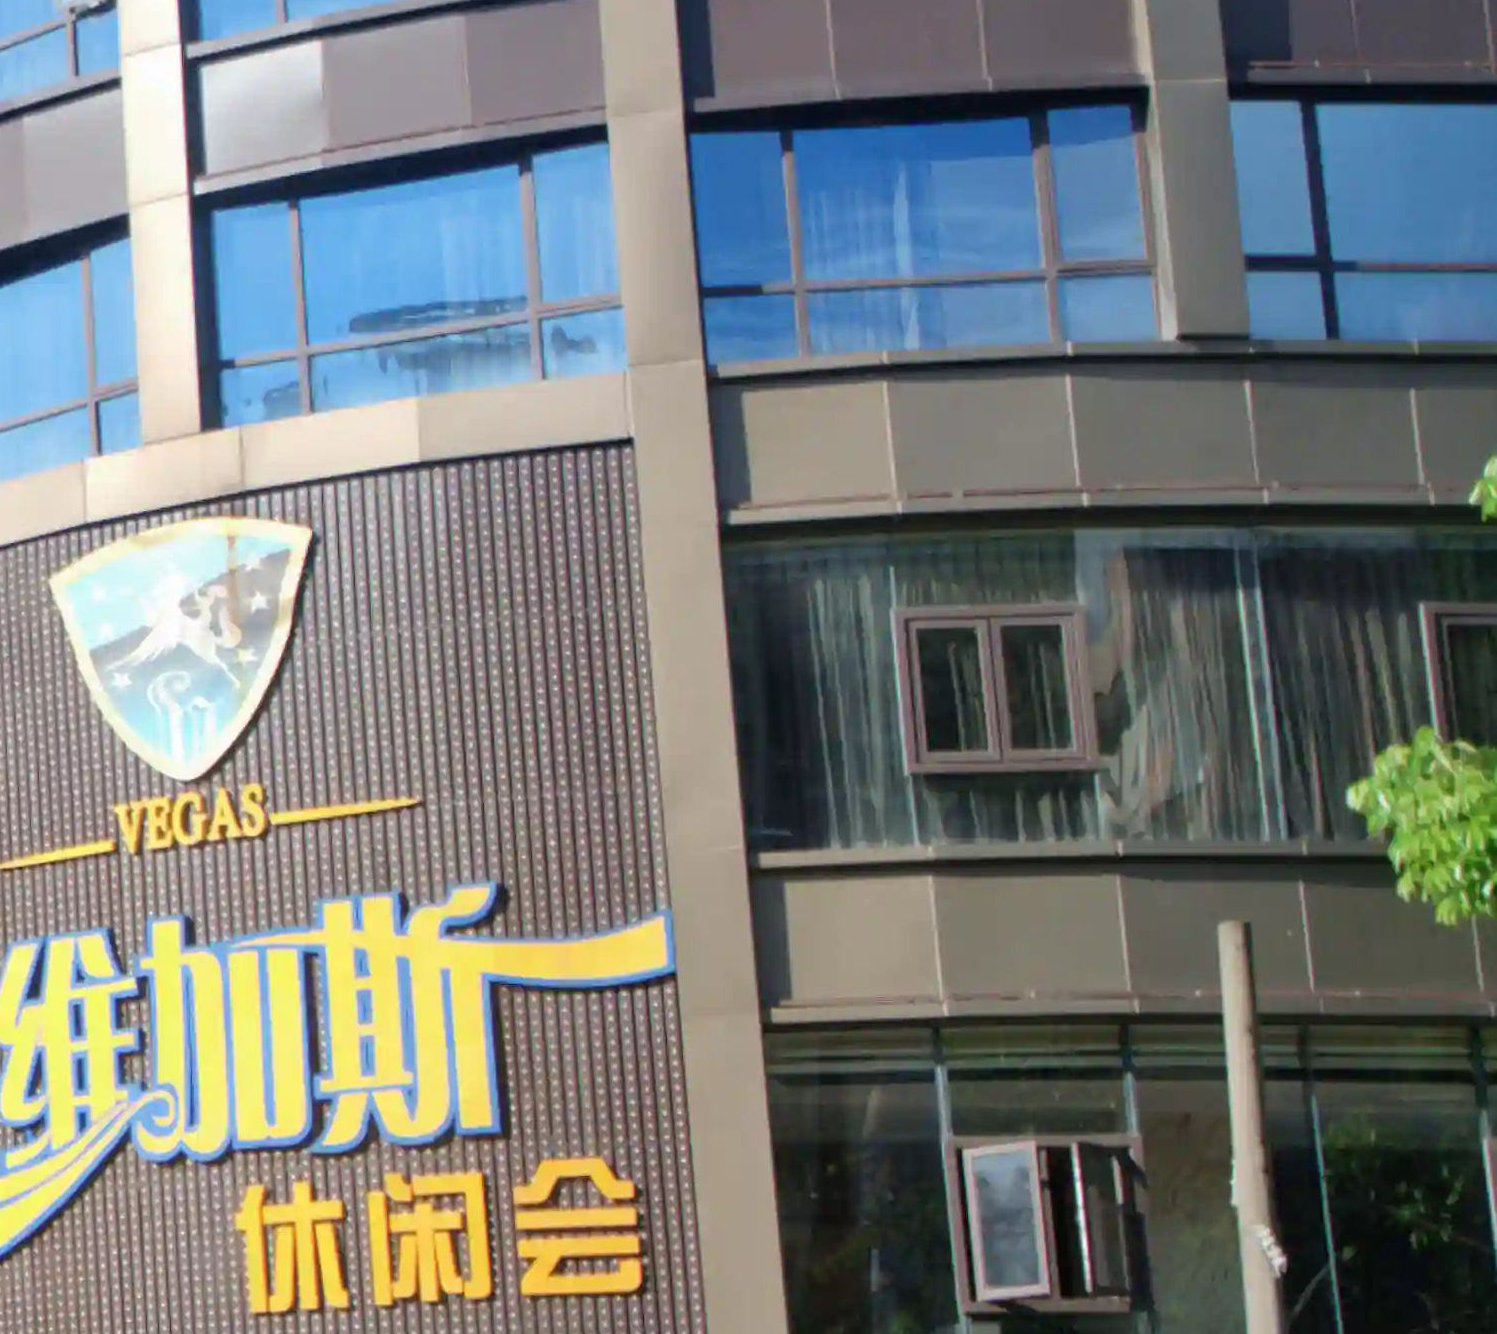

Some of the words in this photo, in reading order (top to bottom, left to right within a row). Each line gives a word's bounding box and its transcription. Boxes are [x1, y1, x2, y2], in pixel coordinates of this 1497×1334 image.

[113, 781, 269, 857] VEGAS
[235, 1154, 645, 1315] 休闲会
